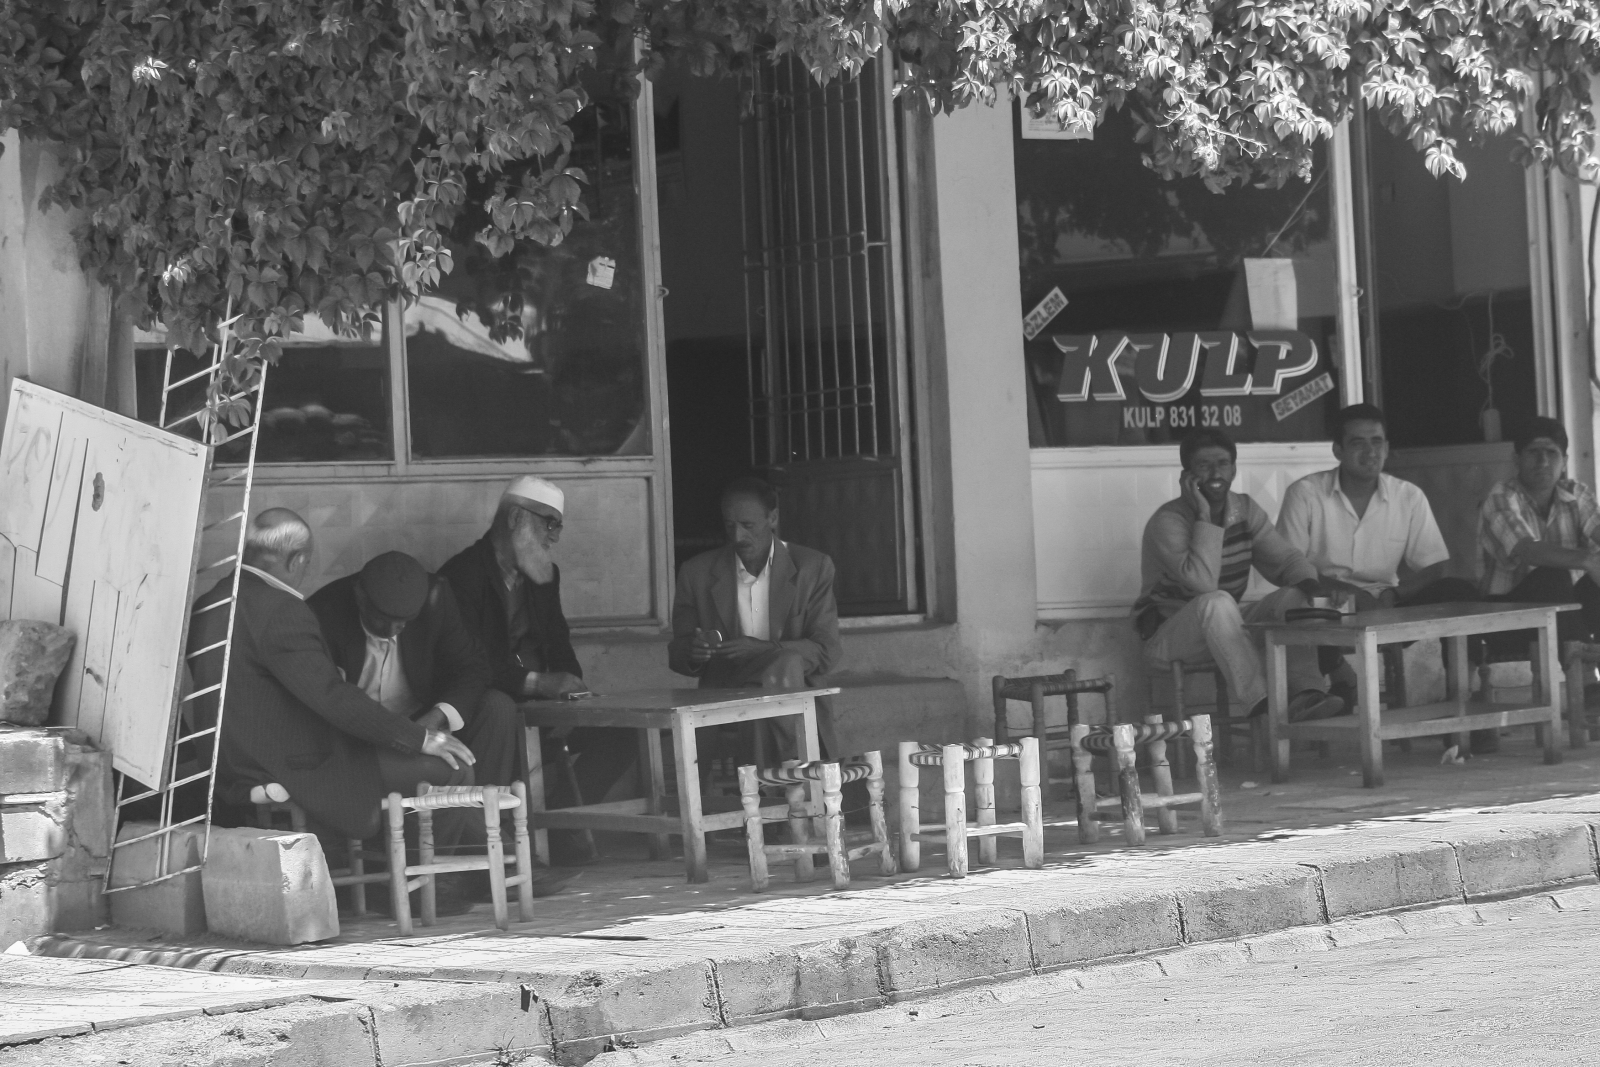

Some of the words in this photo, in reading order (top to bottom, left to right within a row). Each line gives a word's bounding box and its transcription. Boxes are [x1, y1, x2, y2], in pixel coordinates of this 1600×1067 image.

[1052, 330, 1319, 402] KULP
[1123, 406, 1165, 428] KULP
[1169, 405, 1196, 427] 831
[1201, 405, 1220, 426] 32
[1223, 405, 1242, 426] 08
[1274, 374, 1330, 417] SEYAHAT
